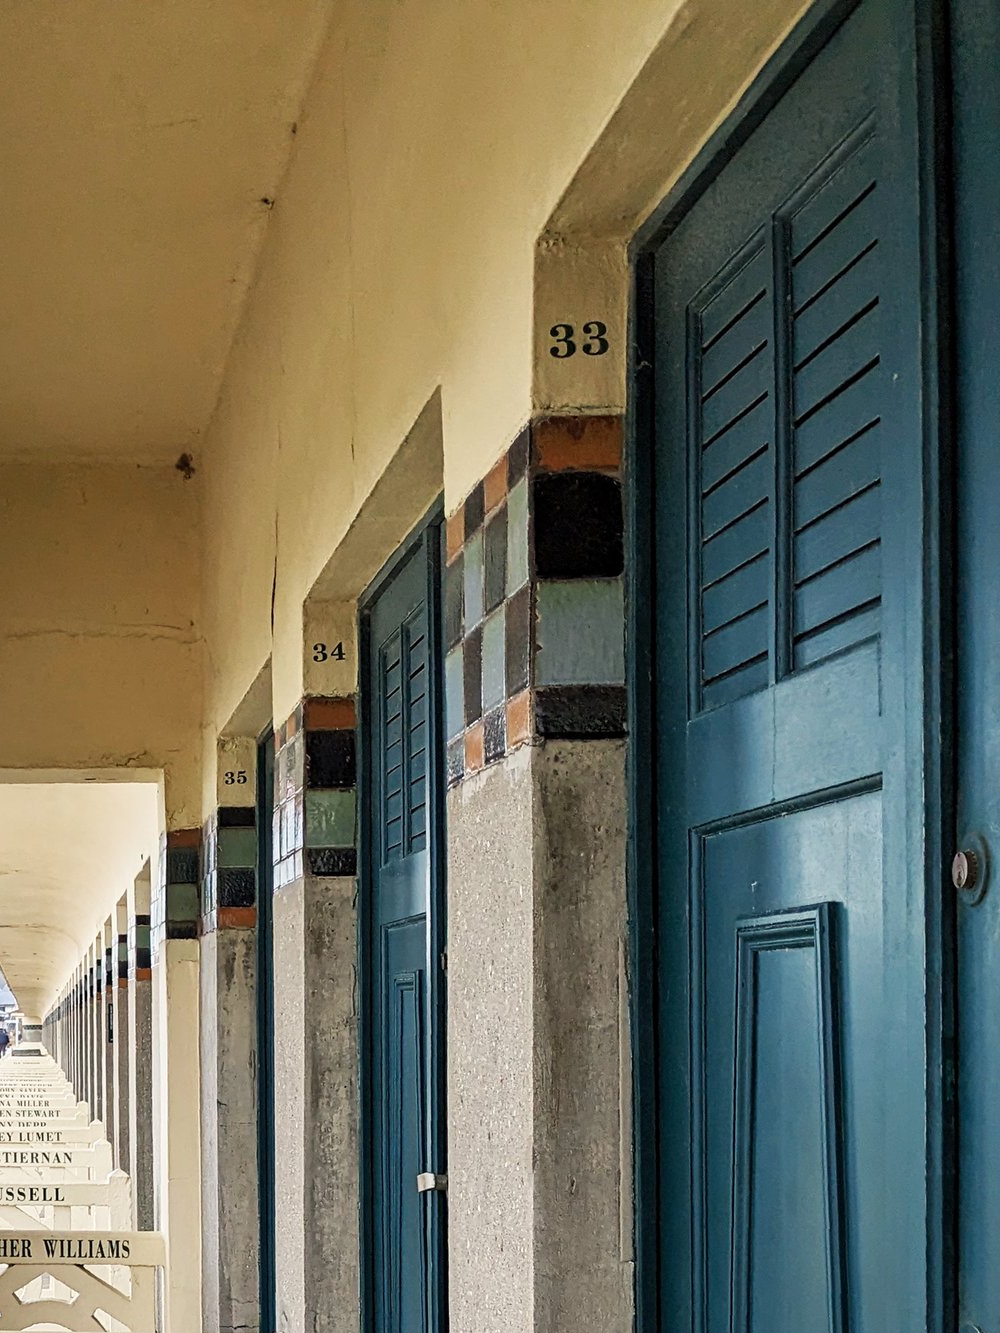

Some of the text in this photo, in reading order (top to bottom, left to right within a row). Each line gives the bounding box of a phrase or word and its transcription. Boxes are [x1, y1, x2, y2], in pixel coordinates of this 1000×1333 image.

[550, 321, 609, 358] 33
[313, 642, 345, 662] 34
[225, 771, 247, 784] 35
[15, 1109, 61, 1118] STEWART
[20, 1132, 62, 1141] LUMET
[43, 1239, 129, 1258] WILLIAMS
